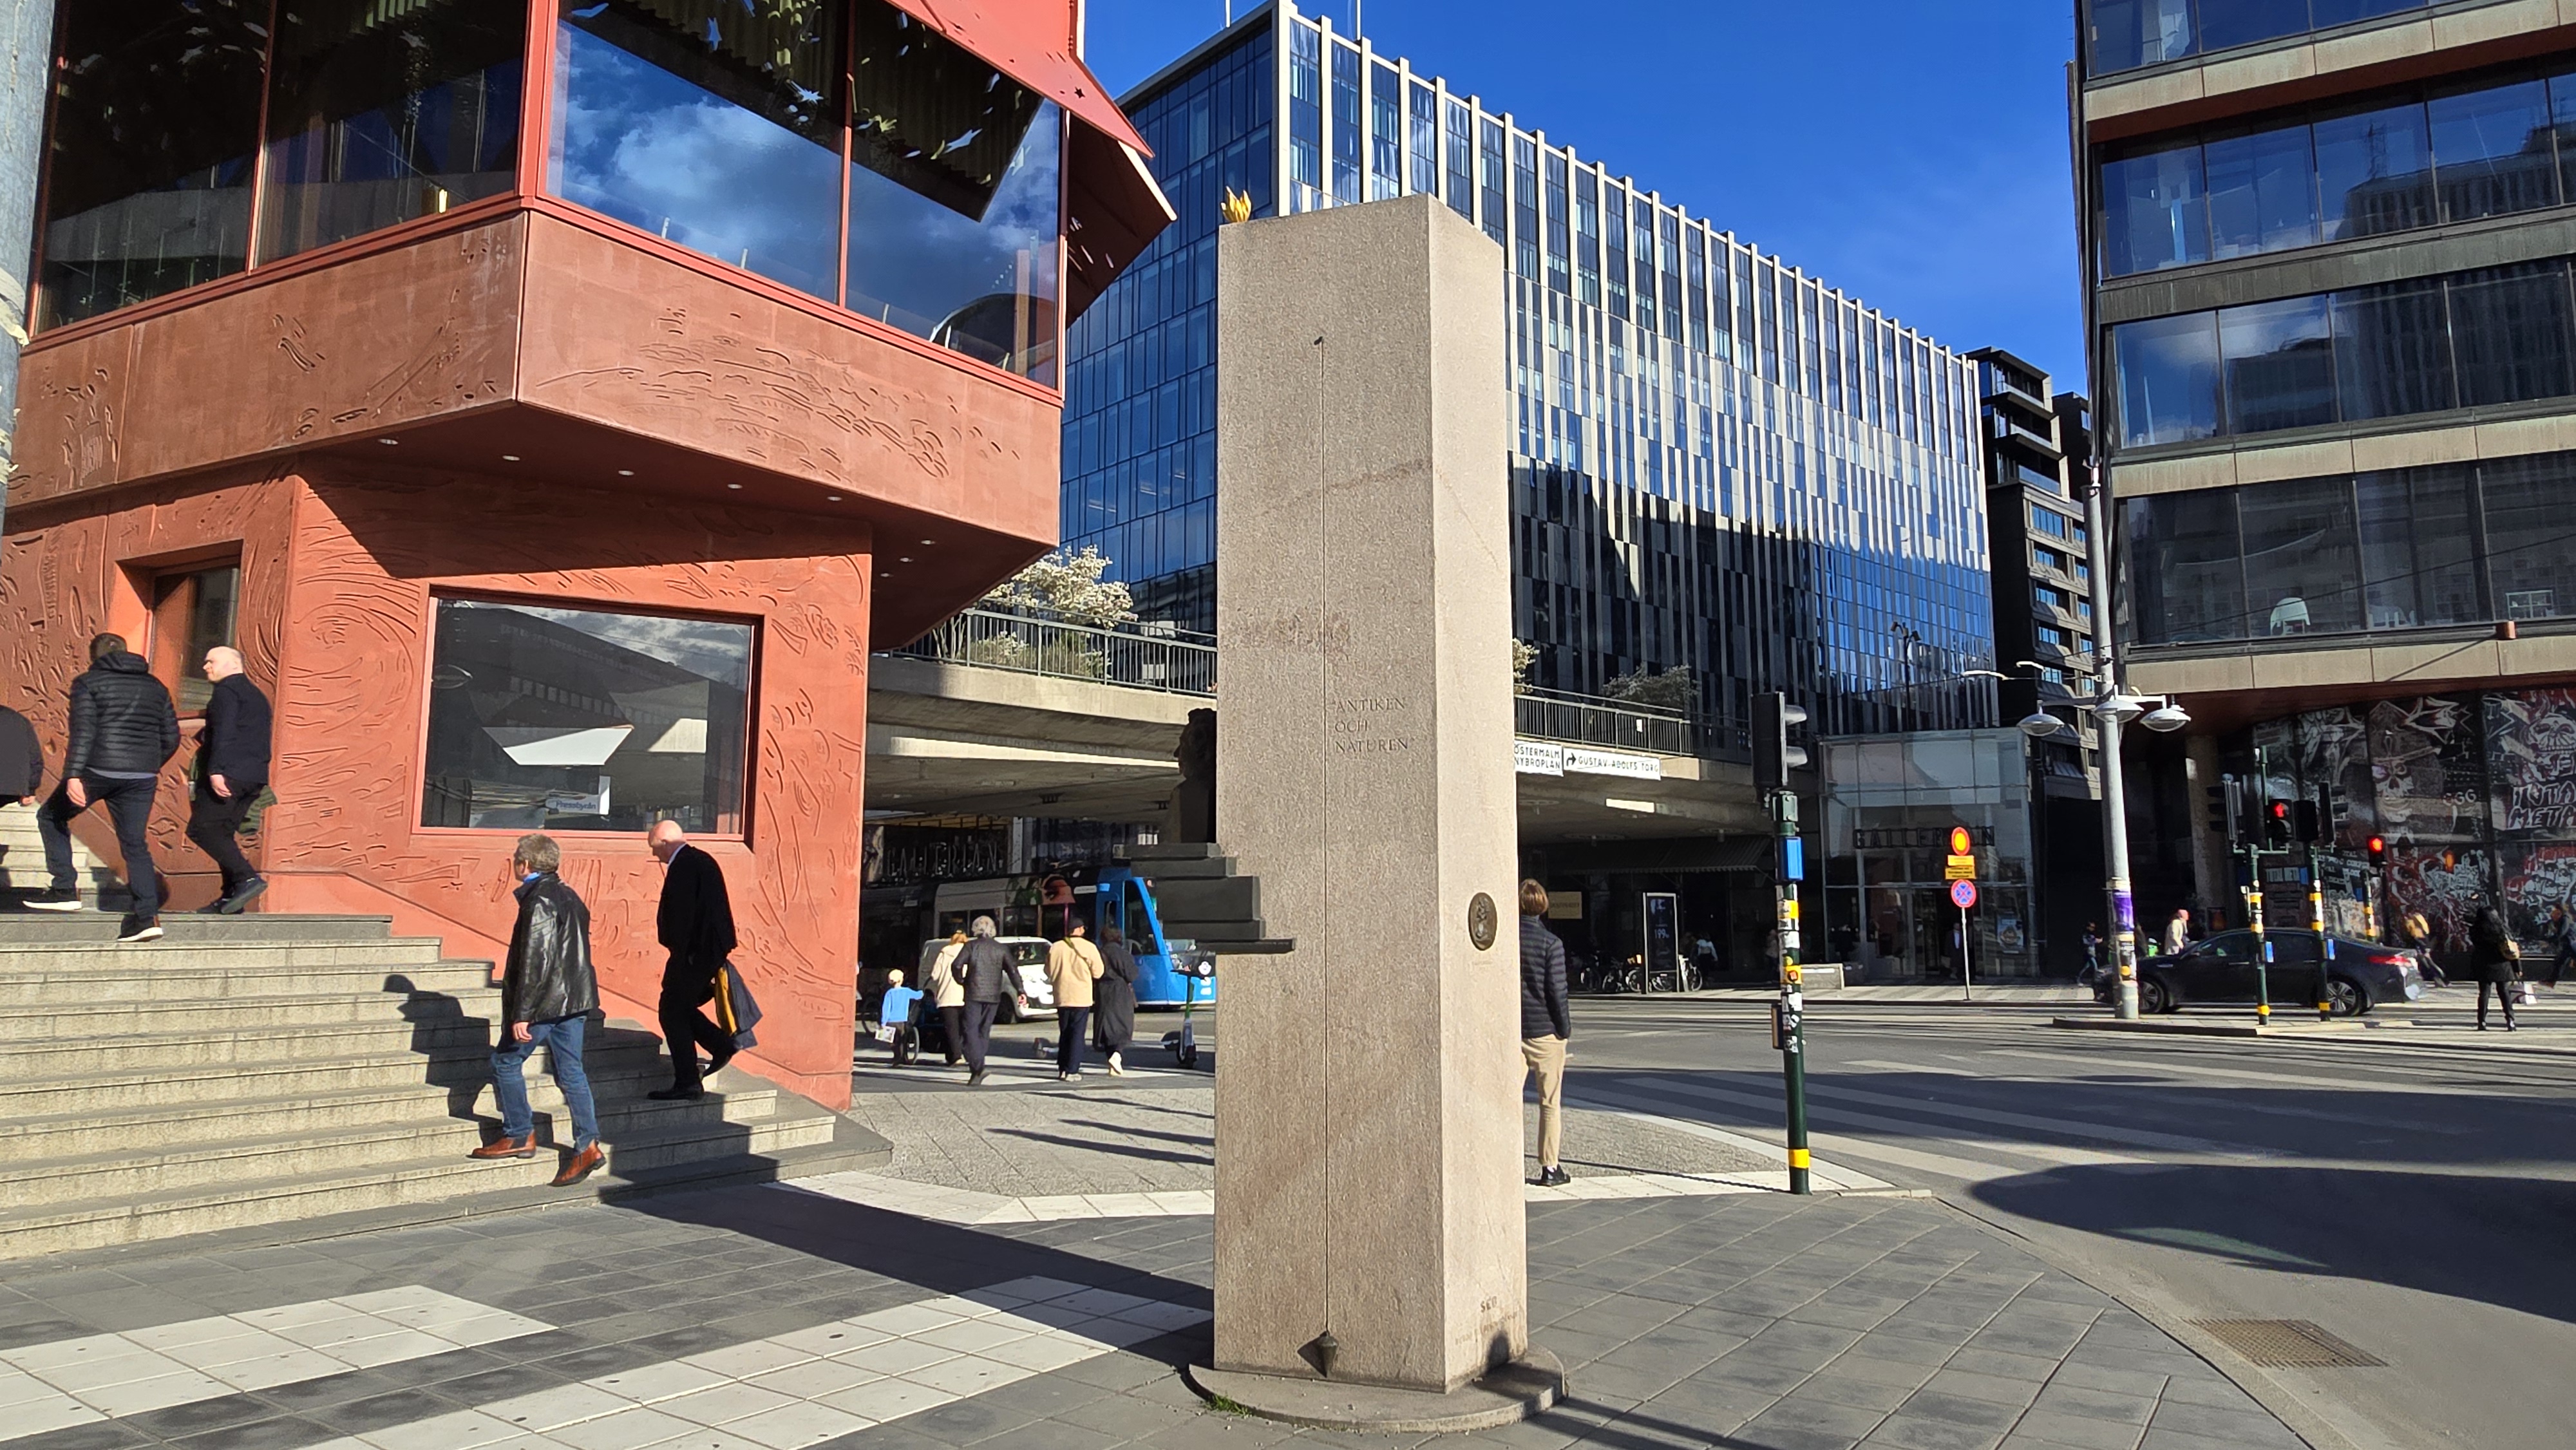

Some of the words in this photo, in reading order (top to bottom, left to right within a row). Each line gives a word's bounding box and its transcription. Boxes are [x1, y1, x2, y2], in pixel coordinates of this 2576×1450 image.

[1335, 720, 1367, 733] OCH
[1514, 744, 1560, 758] ÖSTERMALM
[1514, 757, 1560, 769] NYBROPLAN
[1578, 756, 1607, 767] GUSTAV
[1642, 762, 1659, 773] TORG
[1853, 826, 1995, 849] GALLERN
